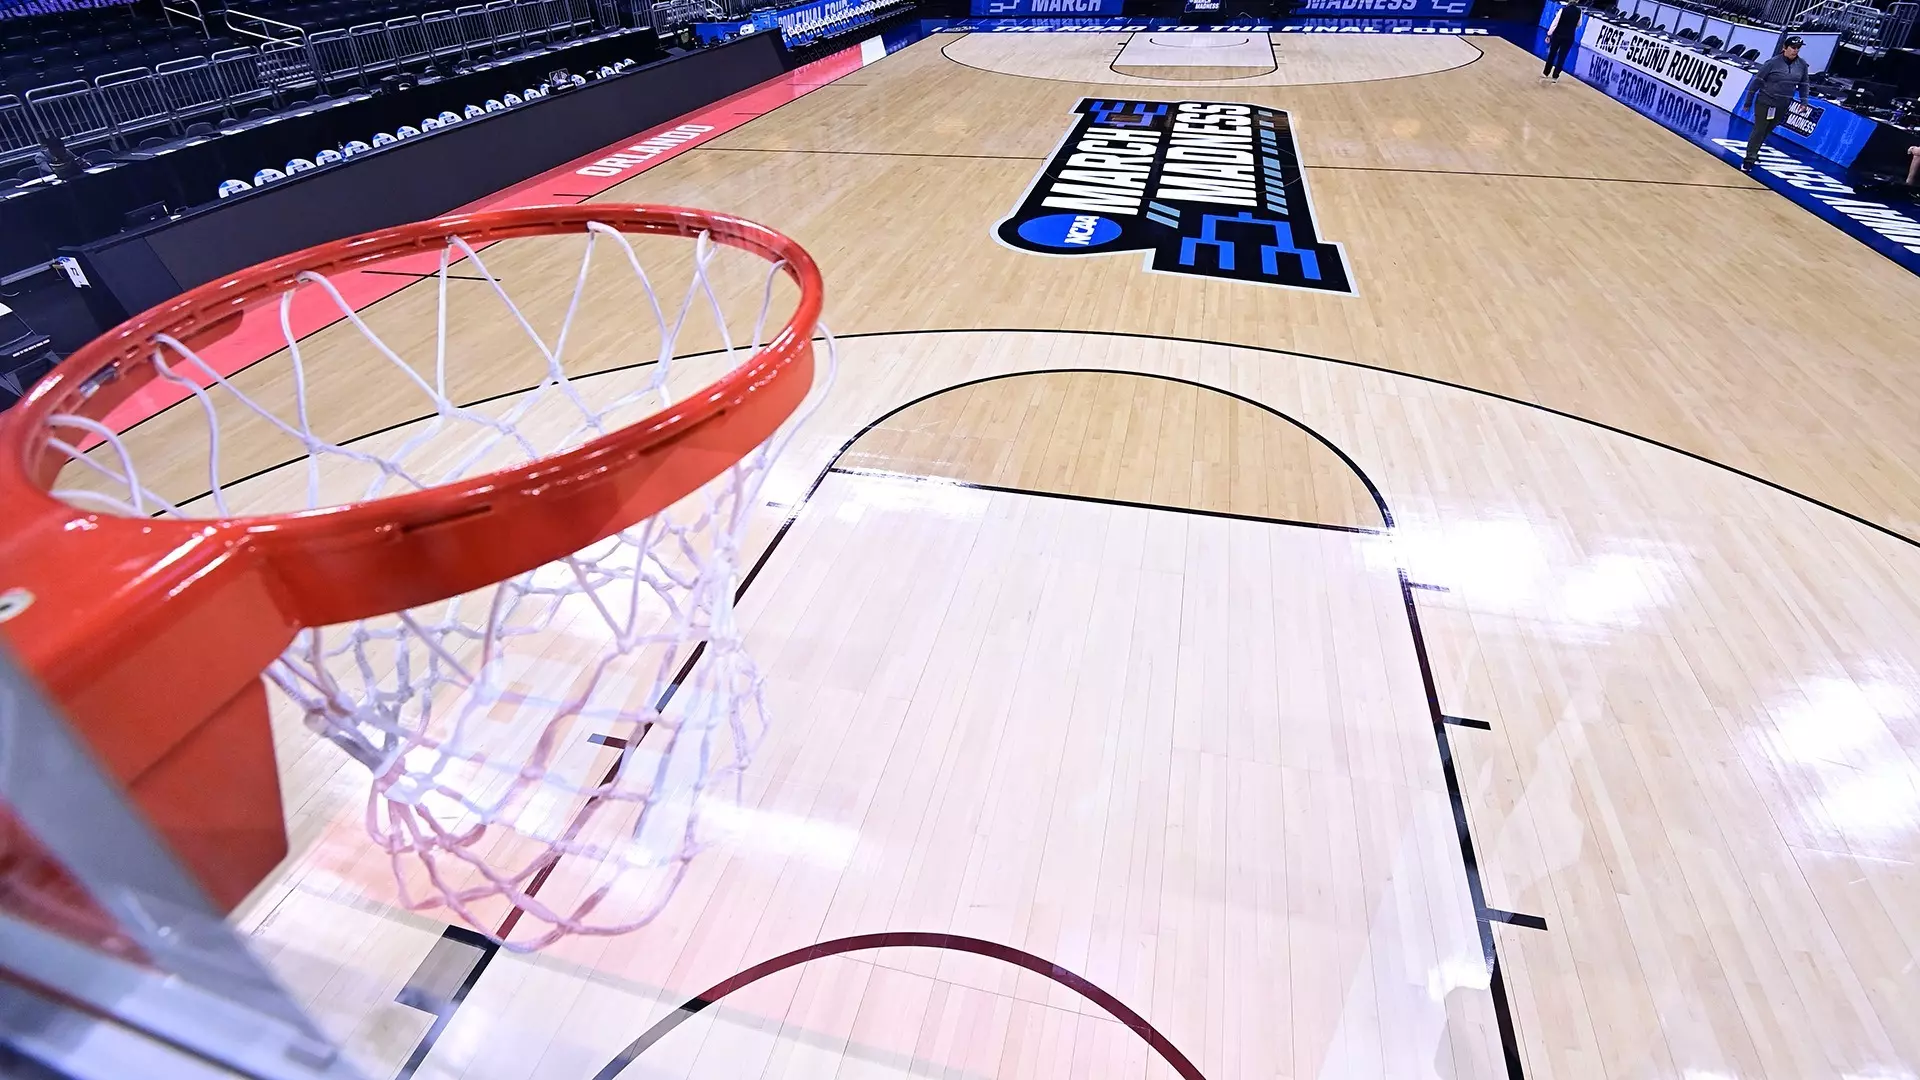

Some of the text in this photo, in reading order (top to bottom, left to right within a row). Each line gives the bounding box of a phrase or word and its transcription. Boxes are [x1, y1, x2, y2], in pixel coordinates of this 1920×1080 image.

[796, 6, 822, 26] FINAL
[1031, 0, 1101, 12] MARCH
[1305, 0, 1417, 10] MADNESS
[1392, 26, 1489, 35] FOUR
[1595, 25, 1625, 55] FIRST
[1626, 35, 1670, 73] SECOND
[1666, 50, 1728, 98] ROUNDS
[1786, 113, 1816, 134] MADNESS
[576, 124, 715, 177] ORLANDO
[1156, 103, 1257, 206] MADNESS
[1041, 127, 1161, 215] MARCH
[1064, 215, 1100, 246] NCAA
